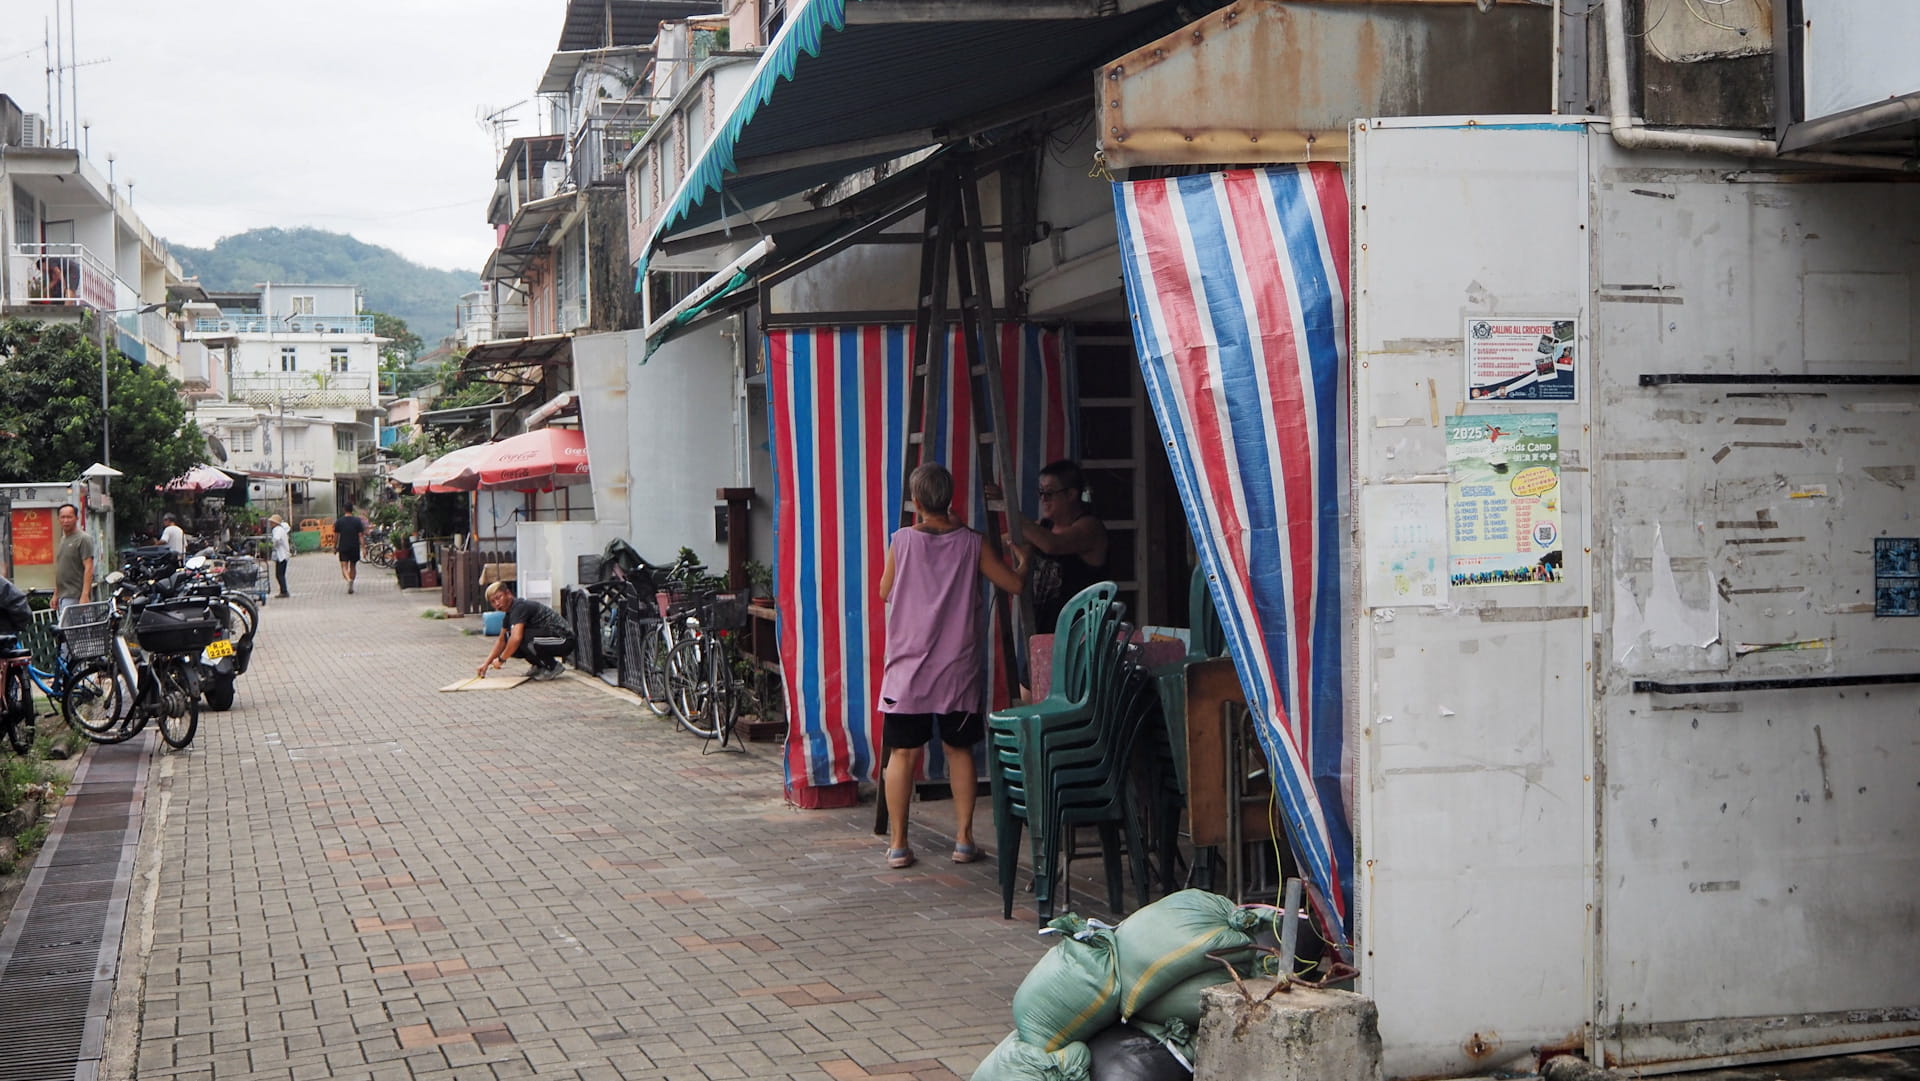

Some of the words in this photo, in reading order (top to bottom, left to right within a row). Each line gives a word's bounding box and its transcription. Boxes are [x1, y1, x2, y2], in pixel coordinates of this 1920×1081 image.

[1492, 325, 1512, 334] CALLING
[1513, 325, 1521, 334] ALL
[1523, 325, 1552, 334] CRICKETERS
[1453, 427, 1482, 440] 2025
[1527, 442, 1552, 453] Camp
